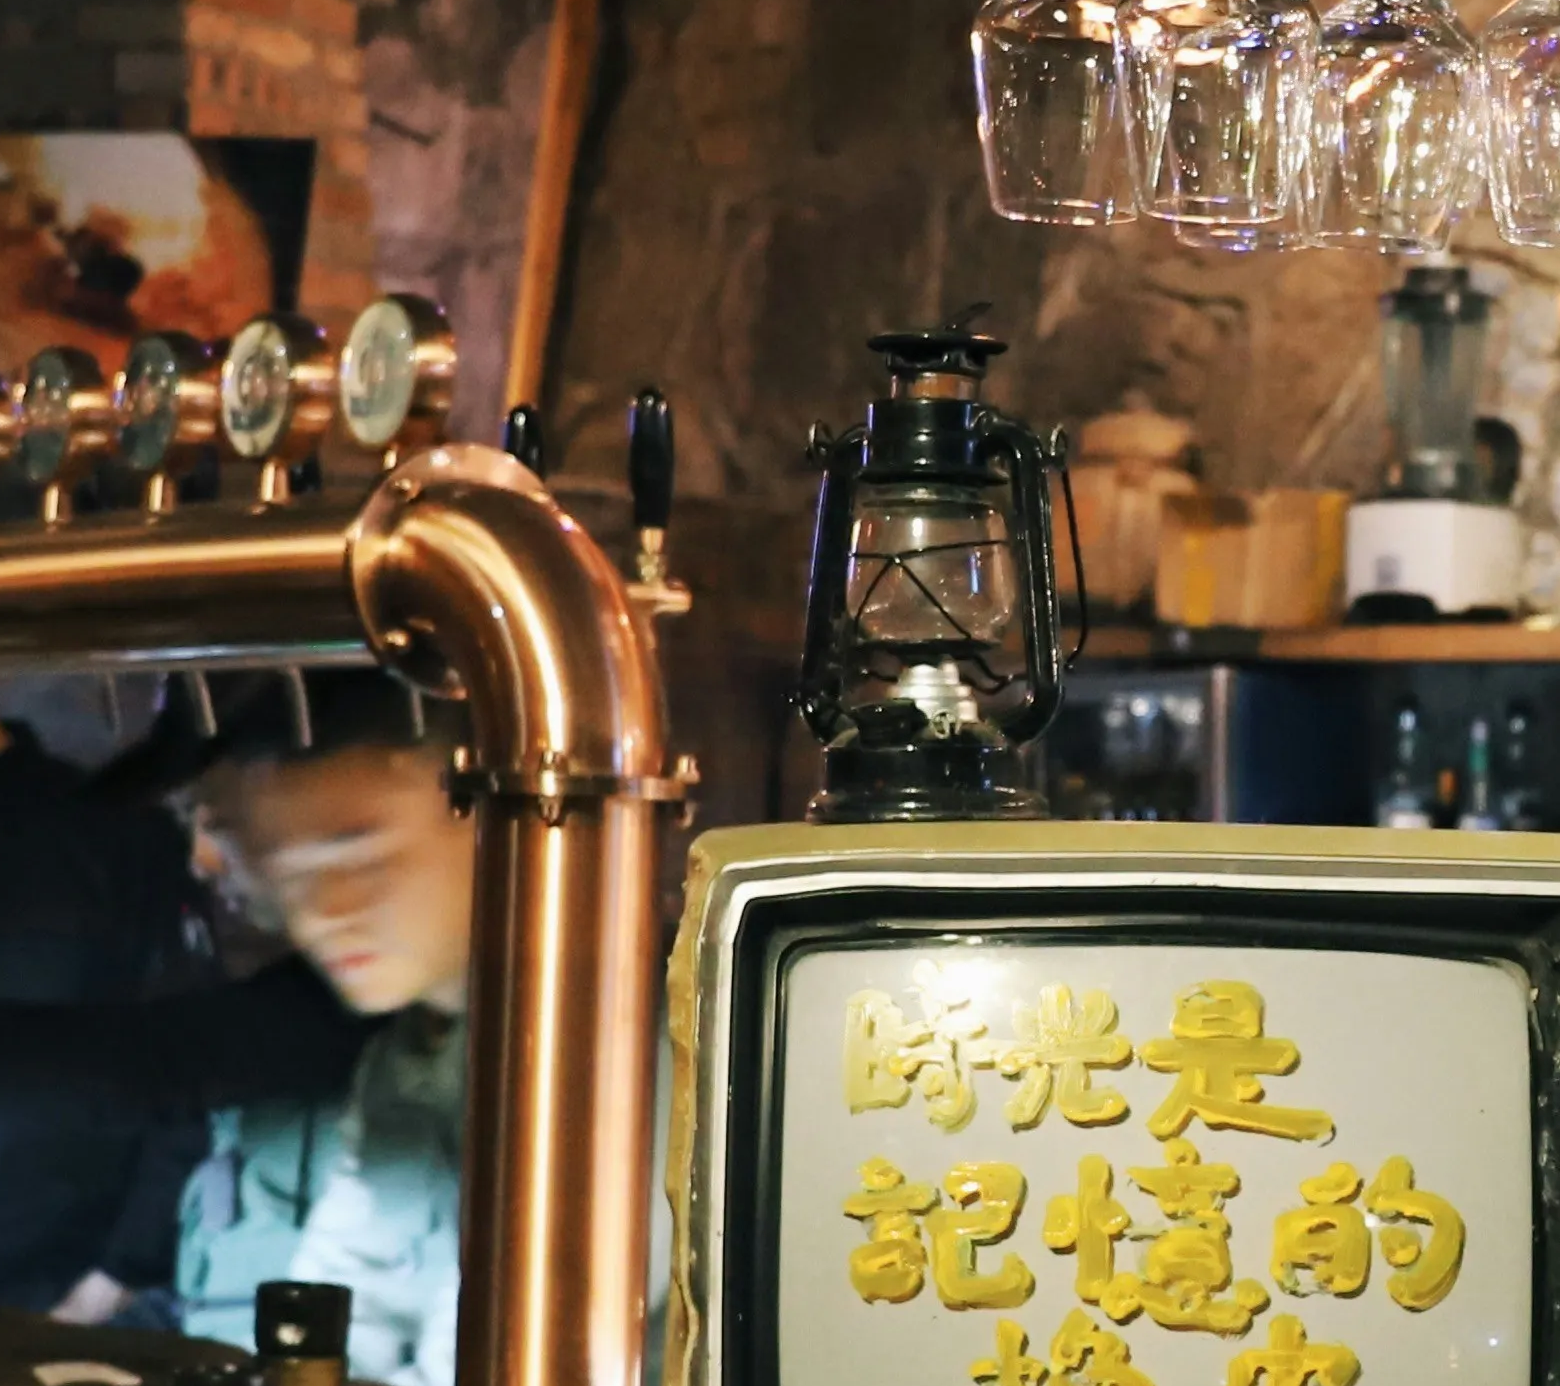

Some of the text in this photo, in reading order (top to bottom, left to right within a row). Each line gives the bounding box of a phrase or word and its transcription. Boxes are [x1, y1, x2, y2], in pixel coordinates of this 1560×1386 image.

[842, 956, 1336, 1148] 時光是
[842, 1137, 1469, 1338] 記憶的
